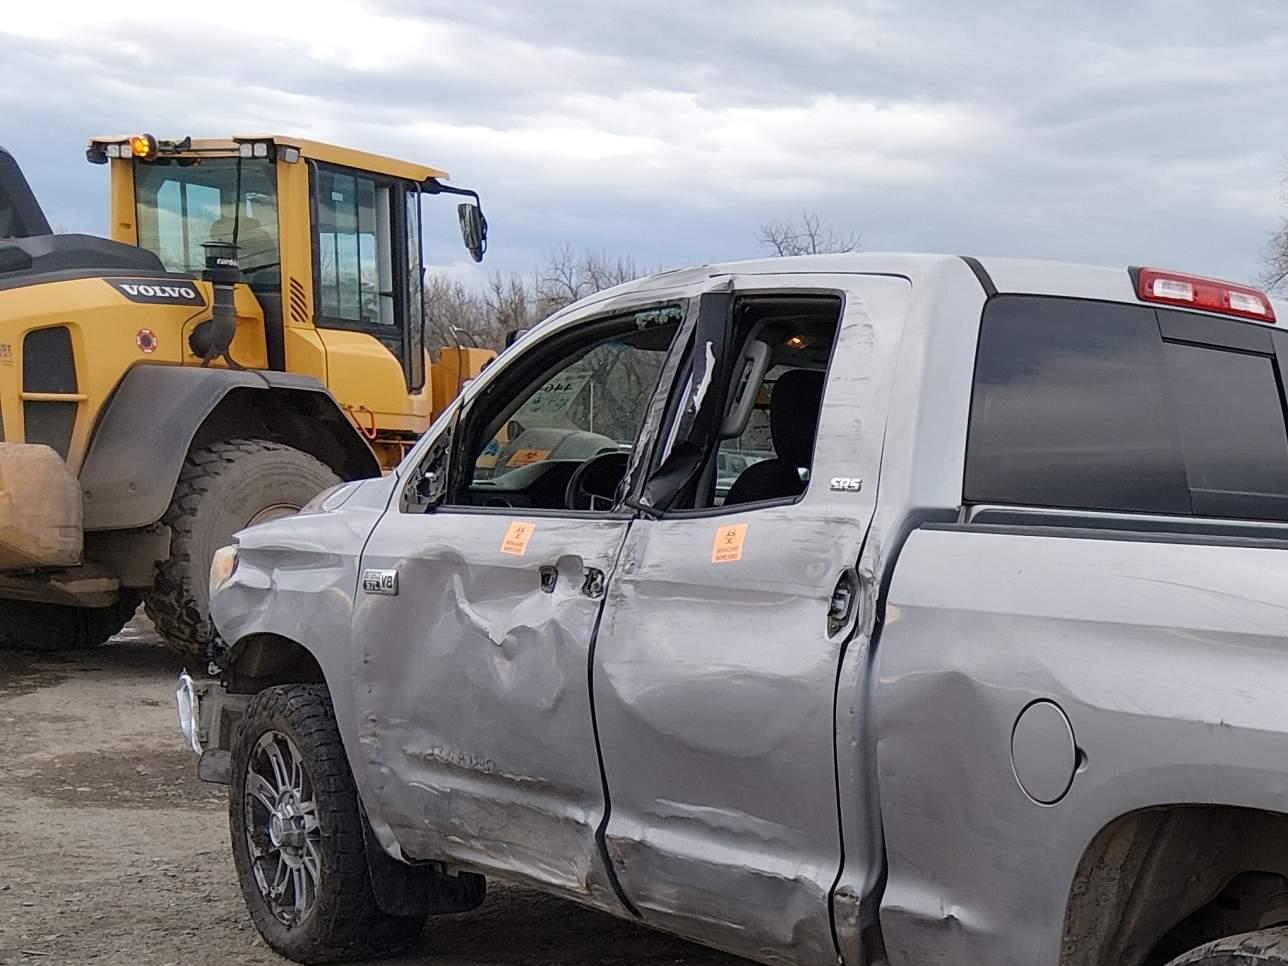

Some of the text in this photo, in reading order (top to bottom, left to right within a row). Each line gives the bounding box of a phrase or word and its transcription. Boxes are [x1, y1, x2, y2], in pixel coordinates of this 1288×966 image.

[119, 284, 196, 299] VOLVO
[830, 477, 862, 492] SR5
[381, 574, 393, 589] V8
